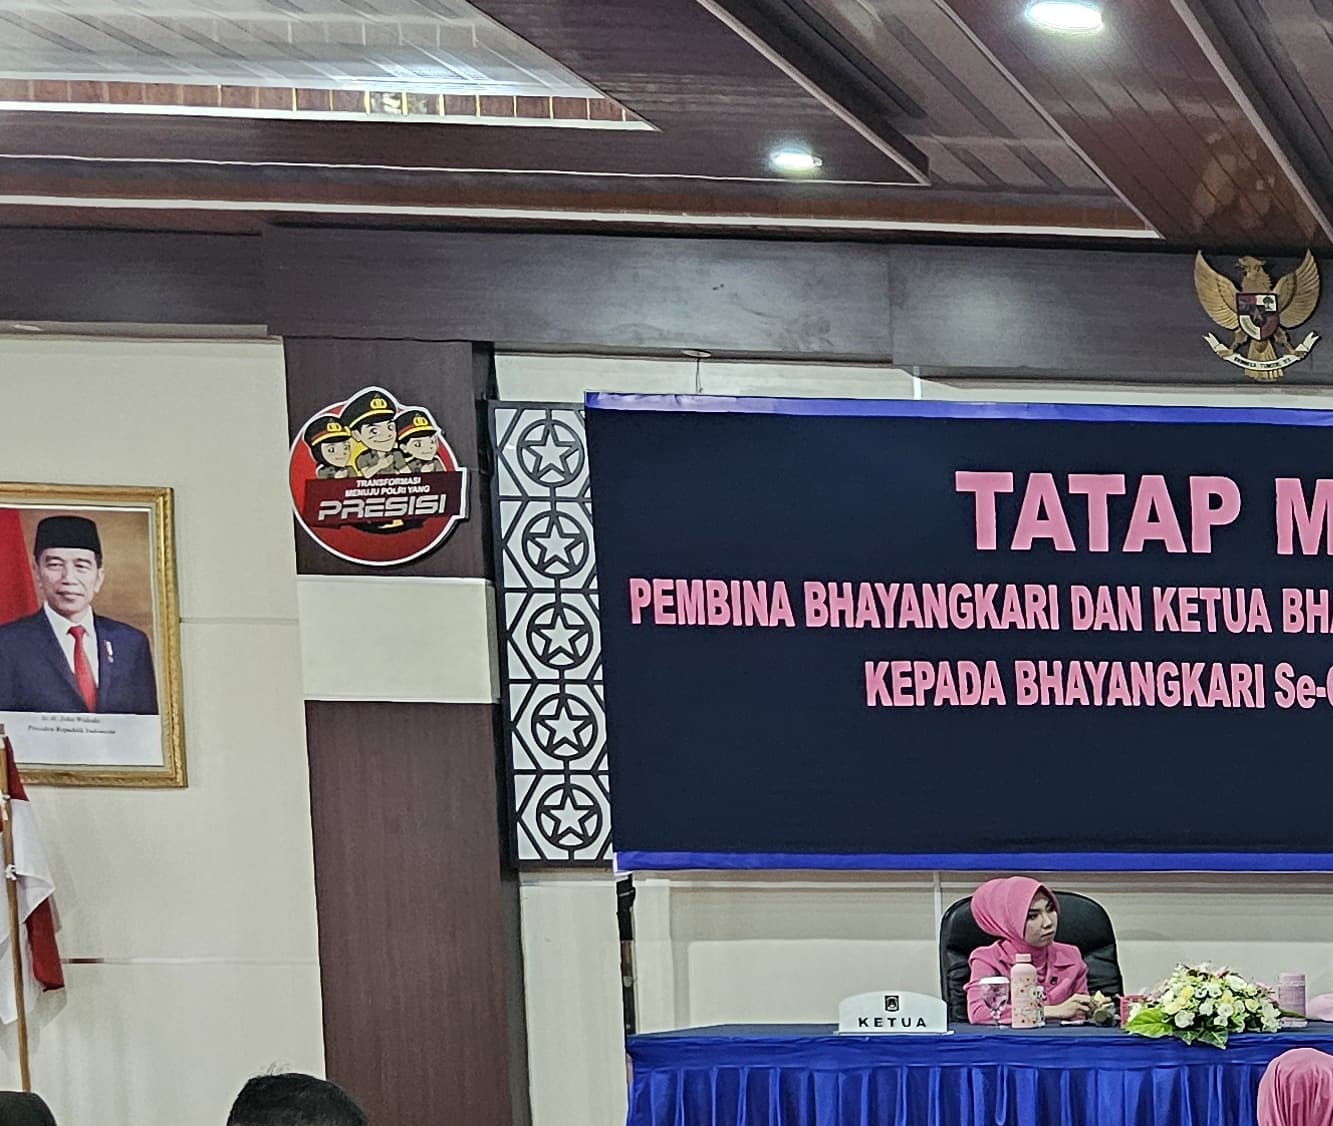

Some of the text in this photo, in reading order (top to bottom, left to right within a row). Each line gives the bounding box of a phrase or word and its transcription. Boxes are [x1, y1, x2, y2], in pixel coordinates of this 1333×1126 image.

[345, 485, 430, 496] MENUJU POLRI YANG
[356, 477, 421, 488] TRANSFORMASI
[318, 495, 446, 520] PRESISI
[956, 470, 1241, 554] TATAP
[629, 578, 796, 628] PEMBINA
[803, 581, 1060, 631] BHAYANGKARI
[1070, 585, 1143, 632] DAN
[1152, 586, 1273, 634] KETUA
[864, 660, 1007, 707] KEPADA
[1014, 660, 1266, 709] BHAYANGKARI
[858, 1017, 927, 1028] KETUA
